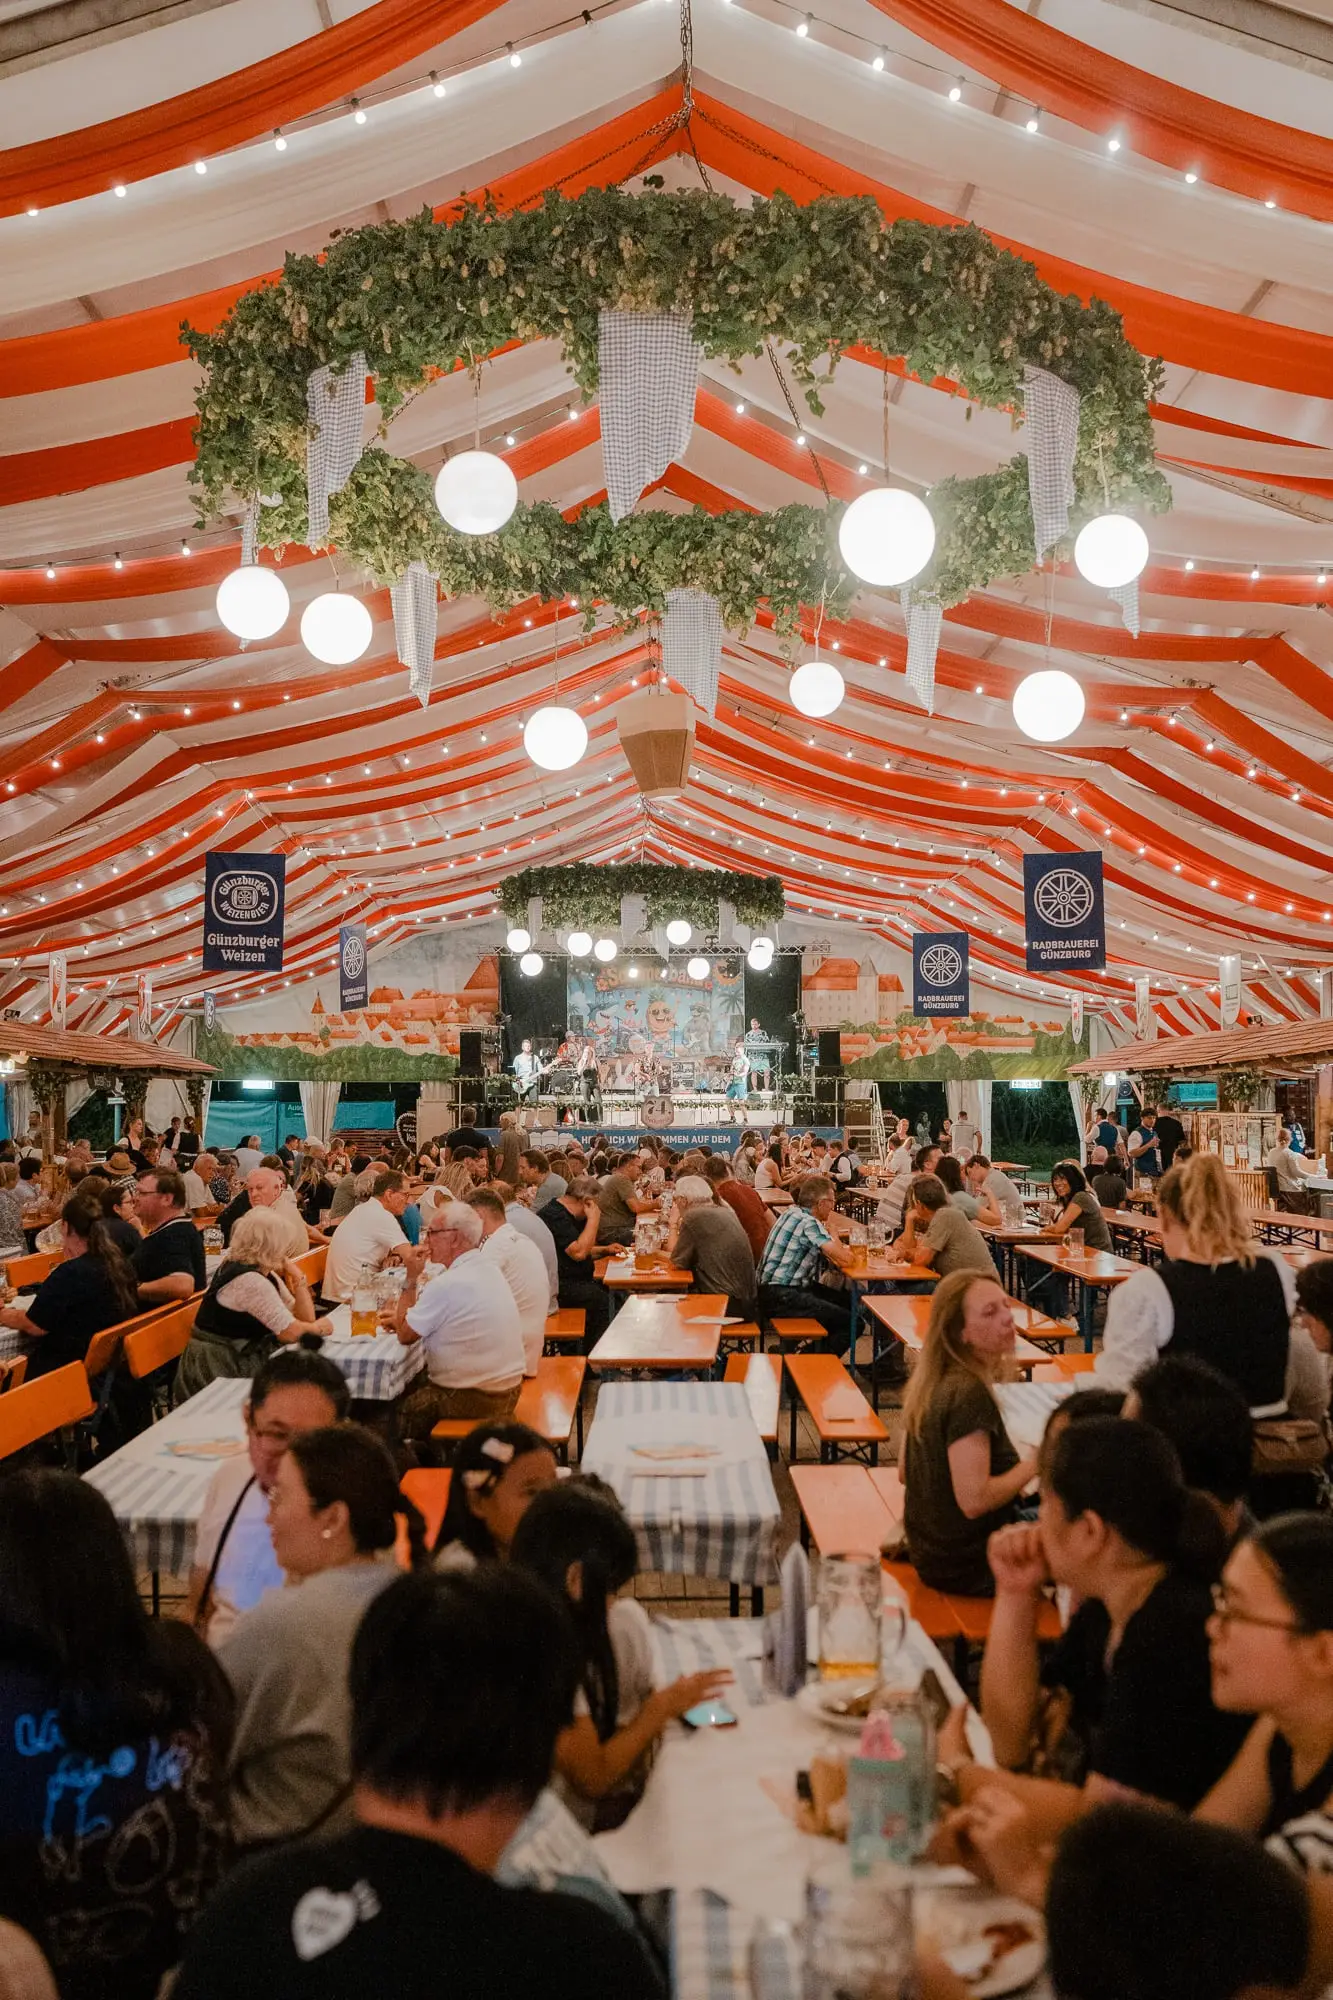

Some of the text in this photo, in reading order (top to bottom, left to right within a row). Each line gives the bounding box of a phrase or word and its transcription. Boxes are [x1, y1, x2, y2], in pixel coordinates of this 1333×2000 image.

[219, 875, 270, 897] Günzburger
[219, 900, 270, 919] WEIZENBIER
[207, 933, 280, 948] Günzburger
[1032, 939, 1099, 950] RADBRAUEREI
[221, 949, 266, 962] Weizen
[1040, 949, 1092, 960] GÜNZBURG
[691, 1135, 710, 1144] AUF
[712, 1135, 731, 1144] DEM
